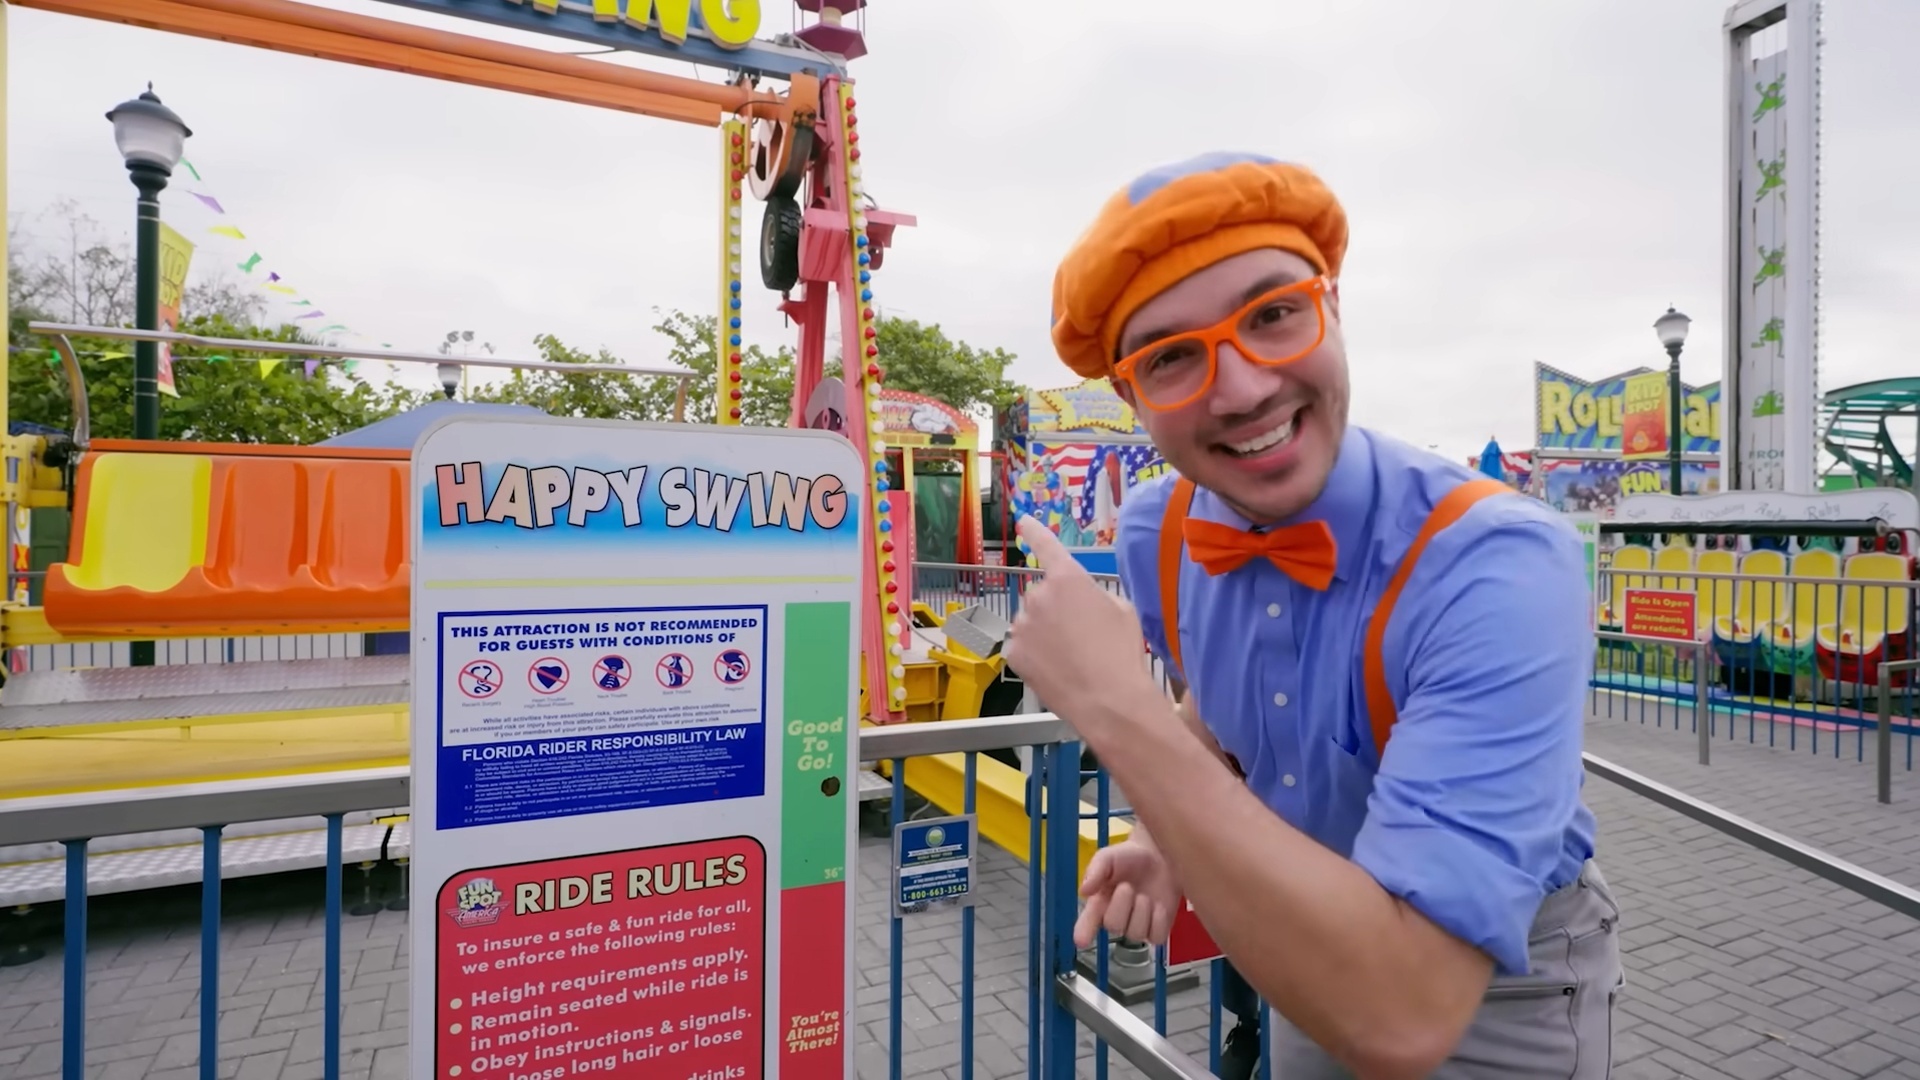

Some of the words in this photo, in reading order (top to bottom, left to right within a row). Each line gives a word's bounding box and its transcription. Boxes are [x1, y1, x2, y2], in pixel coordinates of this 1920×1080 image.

[1632, 380, 1664, 400] KID
[1627, 399, 1660, 415] SPOT
[1620, 471, 1661, 497] FUN
[435, 461, 648, 529] HAPPY
[658, 467, 848, 531] SWING
[1663, 598, 1690, 607] Open
[451, 626, 488, 638] THIS
[493, 623, 590, 636] ATTRACTION
[596, 622, 609, 632] IS
[615, 621, 645, 632] NOT
[650, 618, 758, 631] RECOMMENDED
[479, 641, 510, 652] FOR
[516, 638, 574, 651] GUESTS
[579, 637, 617, 648] WITH
[623, 634, 713, 646] CONDITIONS
[718, 632, 736, 643] OF
[787, 716, 844, 736] Good
[462, 744, 535, 761] FLORIDA
[538, 740, 587, 756] RIDER
[591, 730, 712, 750] RESPONSIBILITY
[716, 727, 747, 741] LAW
[802, 736, 829, 753] To
[797, 753, 834, 771] Go!
[458, 879, 494, 900] FUN
[514, 871, 614, 917] RIDE
[627, 853, 747, 899] RULES
[460, 891, 502, 910] SPOT
[456, 942, 478, 956] To
[484, 934, 543, 952] insure
[549, 931, 559, 941] a
[565, 921, 603, 939] safe
[608, 919, 621, 932] &
[626, 916, 654, 929] fun
[659, 908, 693, 924] ride
[698, 905, 721, 918] for
[725, 899, 751, 914] all,
[462, 961, 489, 974] we
[494, 951, 566, 970] enforce
[571, 942, 599, 957] the
[604, 930, 685, 951] following
[690, 922, 736, 937] rules:
[471, 981, 545, 1007] Height
[551, 958, 687, 992] requirements
[692, 947, 748, 969] apply.
[471, 1004, 552, 1031] Remain
[558, 987, 627, 1014] seated
[633, 979, 685, 1000] while
[691, 971, 728, 989] ride
[734, 968, 748, 982] is
[791, 1010, 839, 1028] You're
[470, 1036, 491, 1051] in
[498, 1021, 579, 1046] motion.
[471, 1052, 529, 1073] Obey
[535, 1026, 654, 1060] instructions
[660, 1020, 674, 1035] &
[679, 1006, 752, 1030] signals.
[786, 1021, 840, 1042] Almost
[571, 1055, 616, 1074] long
[622, 1044, 663, 1063] hair
[668, 1040, 689, 1054] or
[694, 1029, 743, 1048] loose
[789, 1033, 838, 1054] There!
